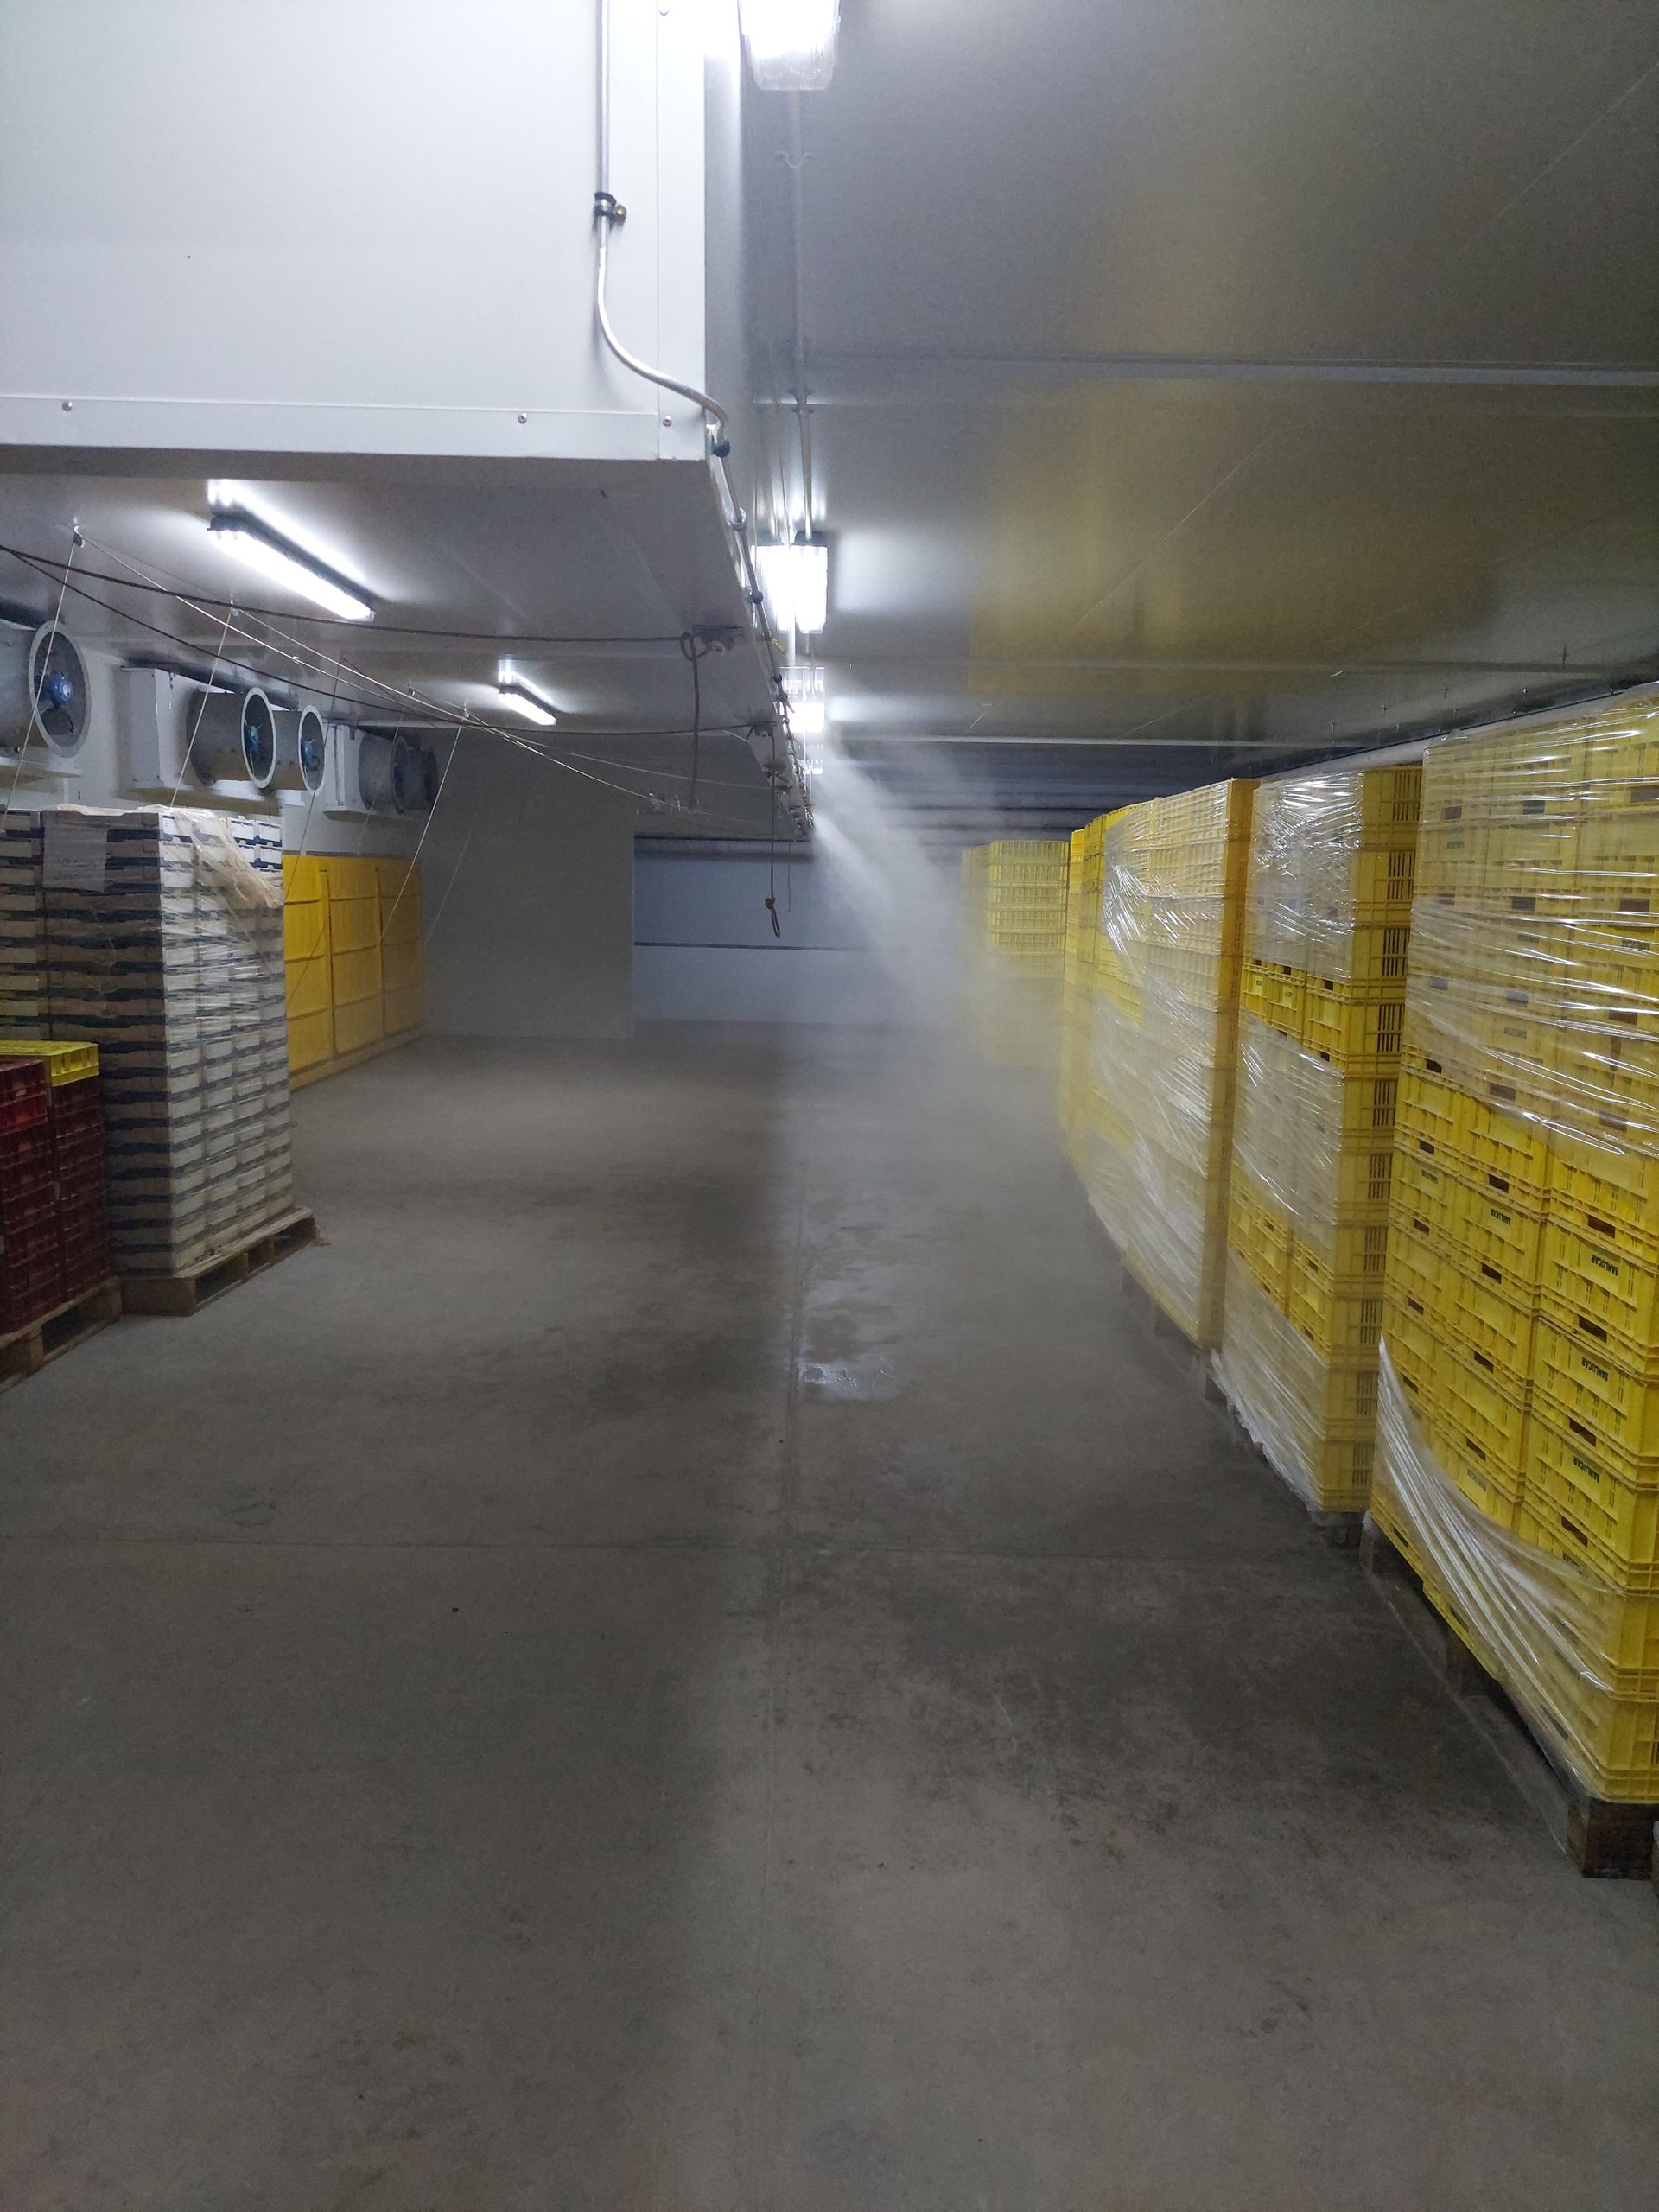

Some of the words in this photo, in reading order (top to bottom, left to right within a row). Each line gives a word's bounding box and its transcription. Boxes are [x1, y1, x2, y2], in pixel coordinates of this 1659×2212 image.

[1591, 1254, 1618, 1276] SANLUCAR
[1581, 1357, 1608, 1382] SANLUCAR
[1573, 1455, 1600, 1484] SANLUCAR
